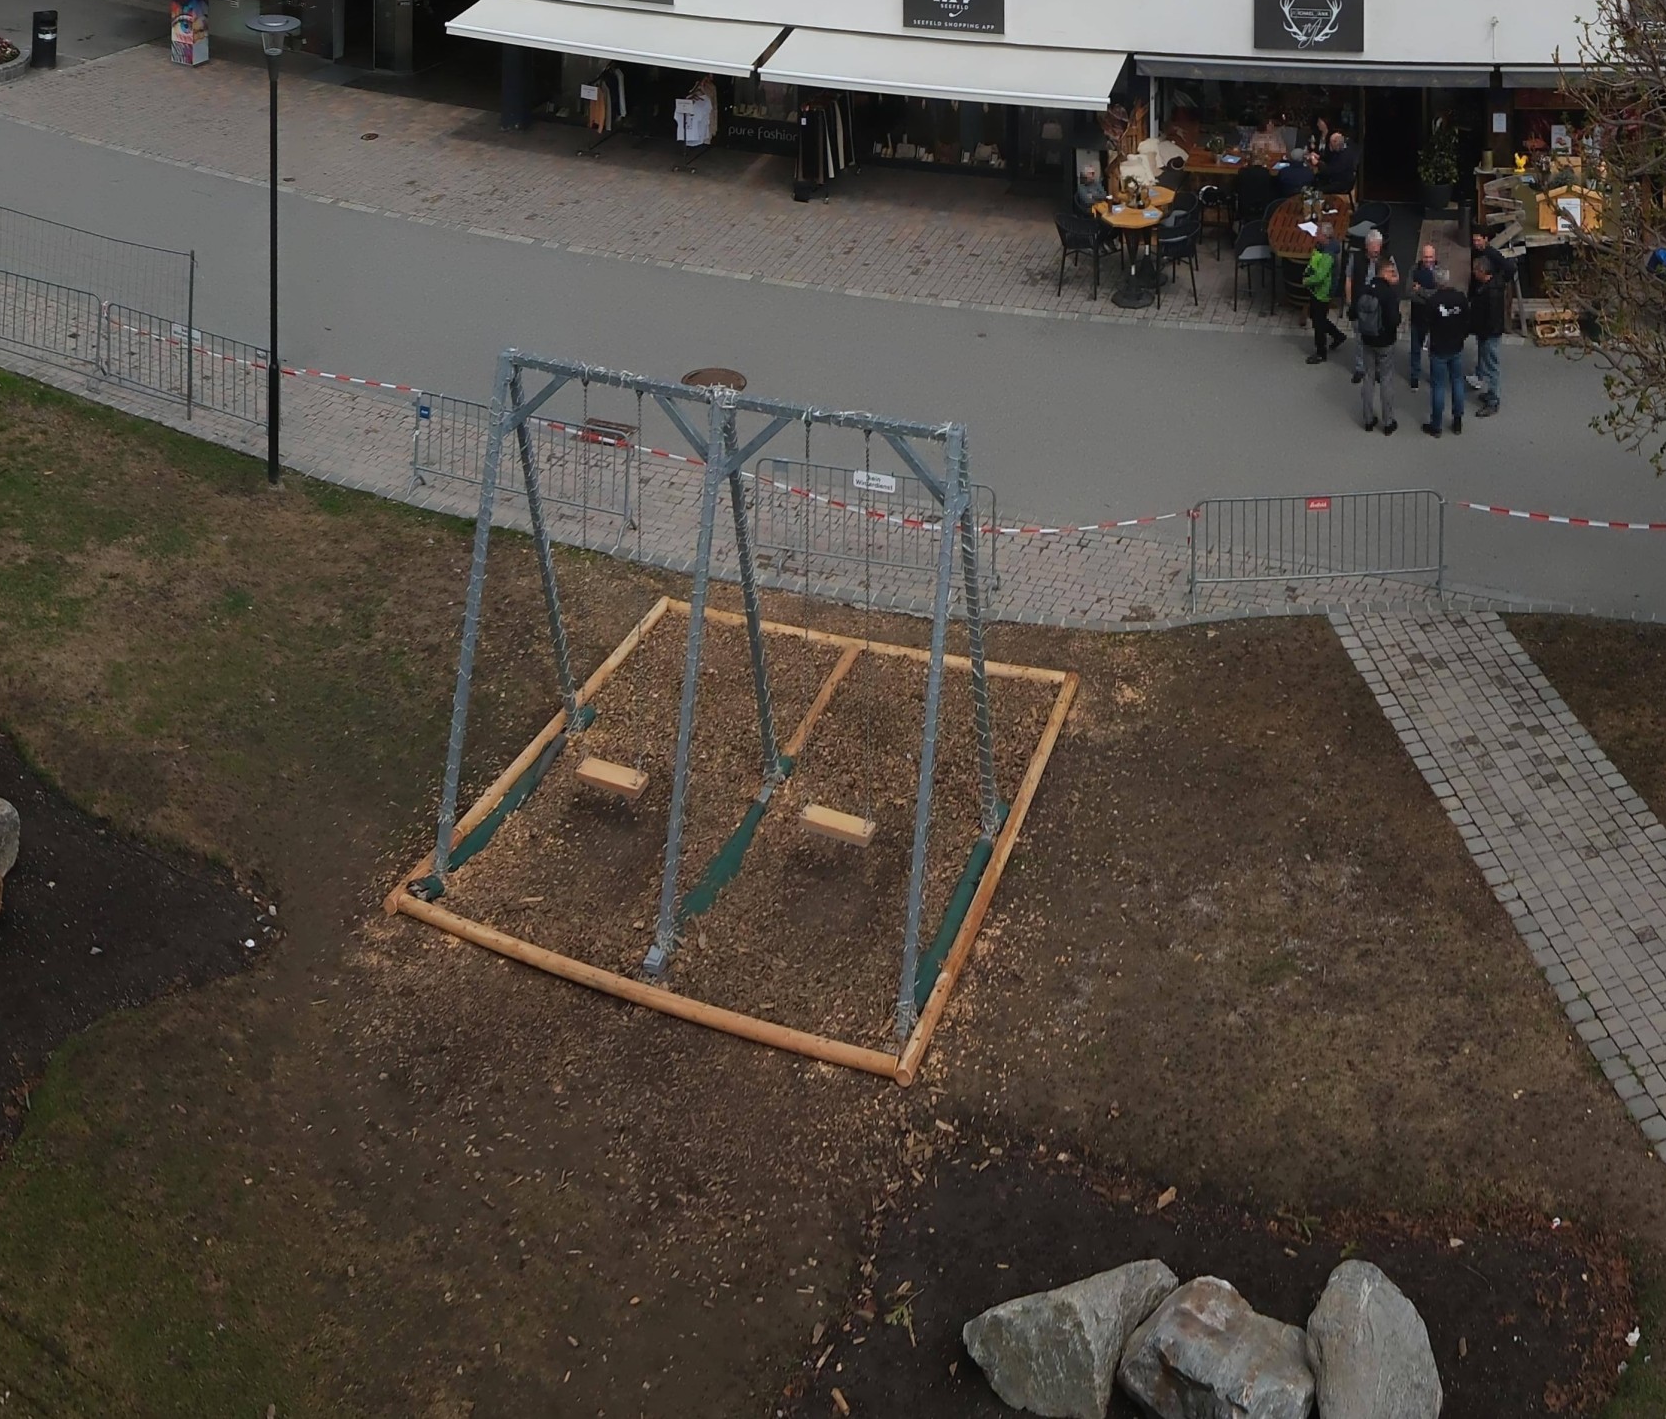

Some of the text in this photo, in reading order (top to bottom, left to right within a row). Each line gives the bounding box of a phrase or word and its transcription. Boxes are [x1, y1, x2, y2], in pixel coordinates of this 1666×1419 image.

[913, 19, 942, 27] SEEFELD
[944, 21, 980, 30] SHOPPING
[728, 125, 755, 137] pure
